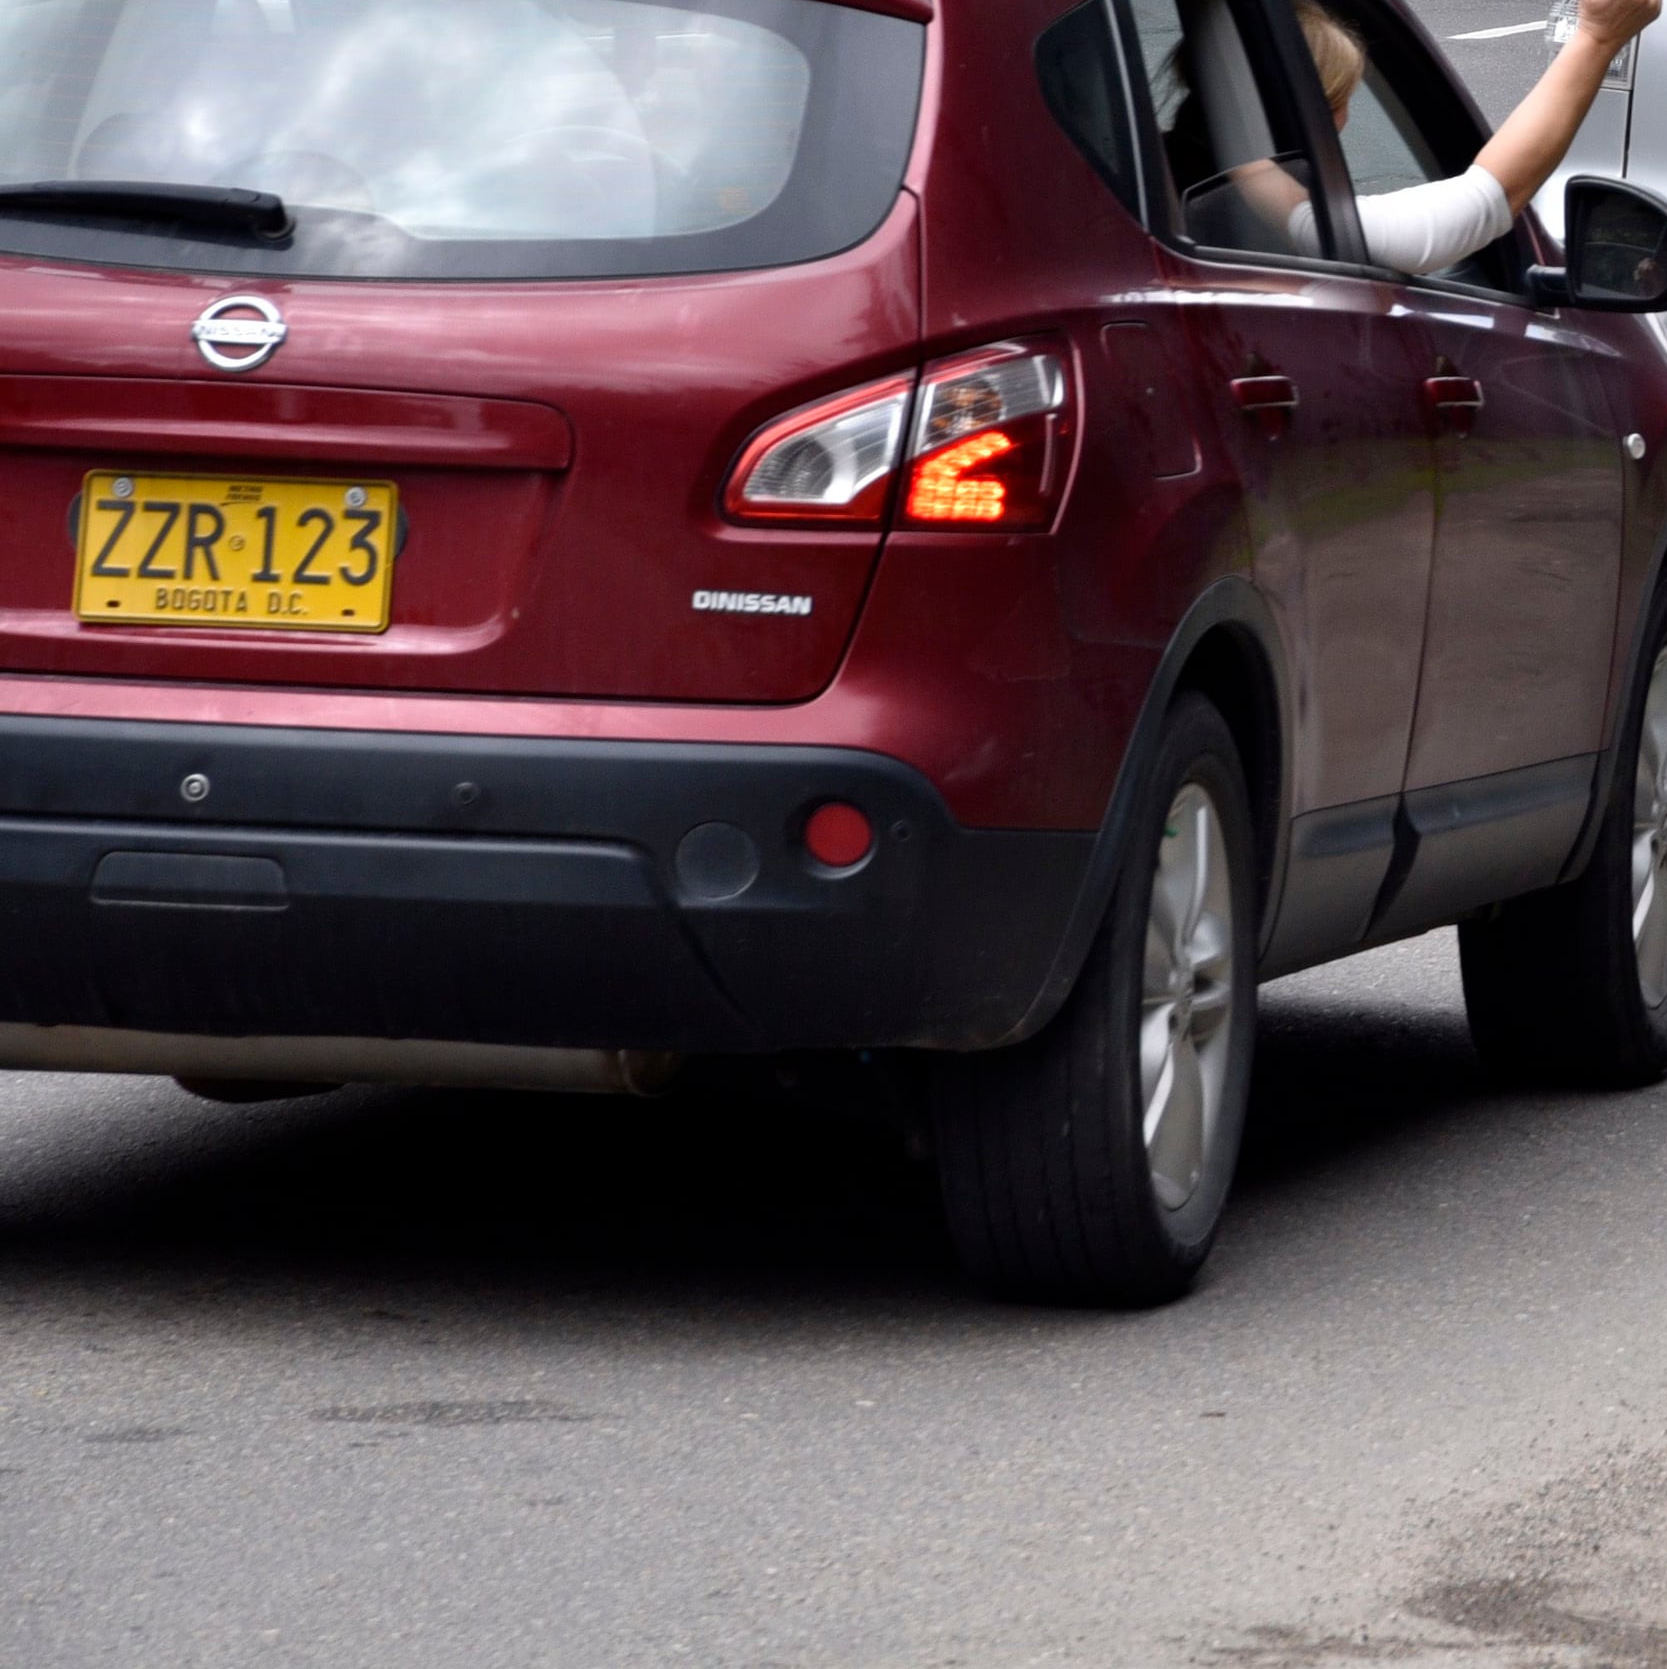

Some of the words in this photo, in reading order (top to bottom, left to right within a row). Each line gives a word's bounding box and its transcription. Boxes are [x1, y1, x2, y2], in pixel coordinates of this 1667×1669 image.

[155, 587, 248, 613] BOGOTA
[267, 592, 309, 616] D.C.
[692, 590, 812, 615] DINISSAN
